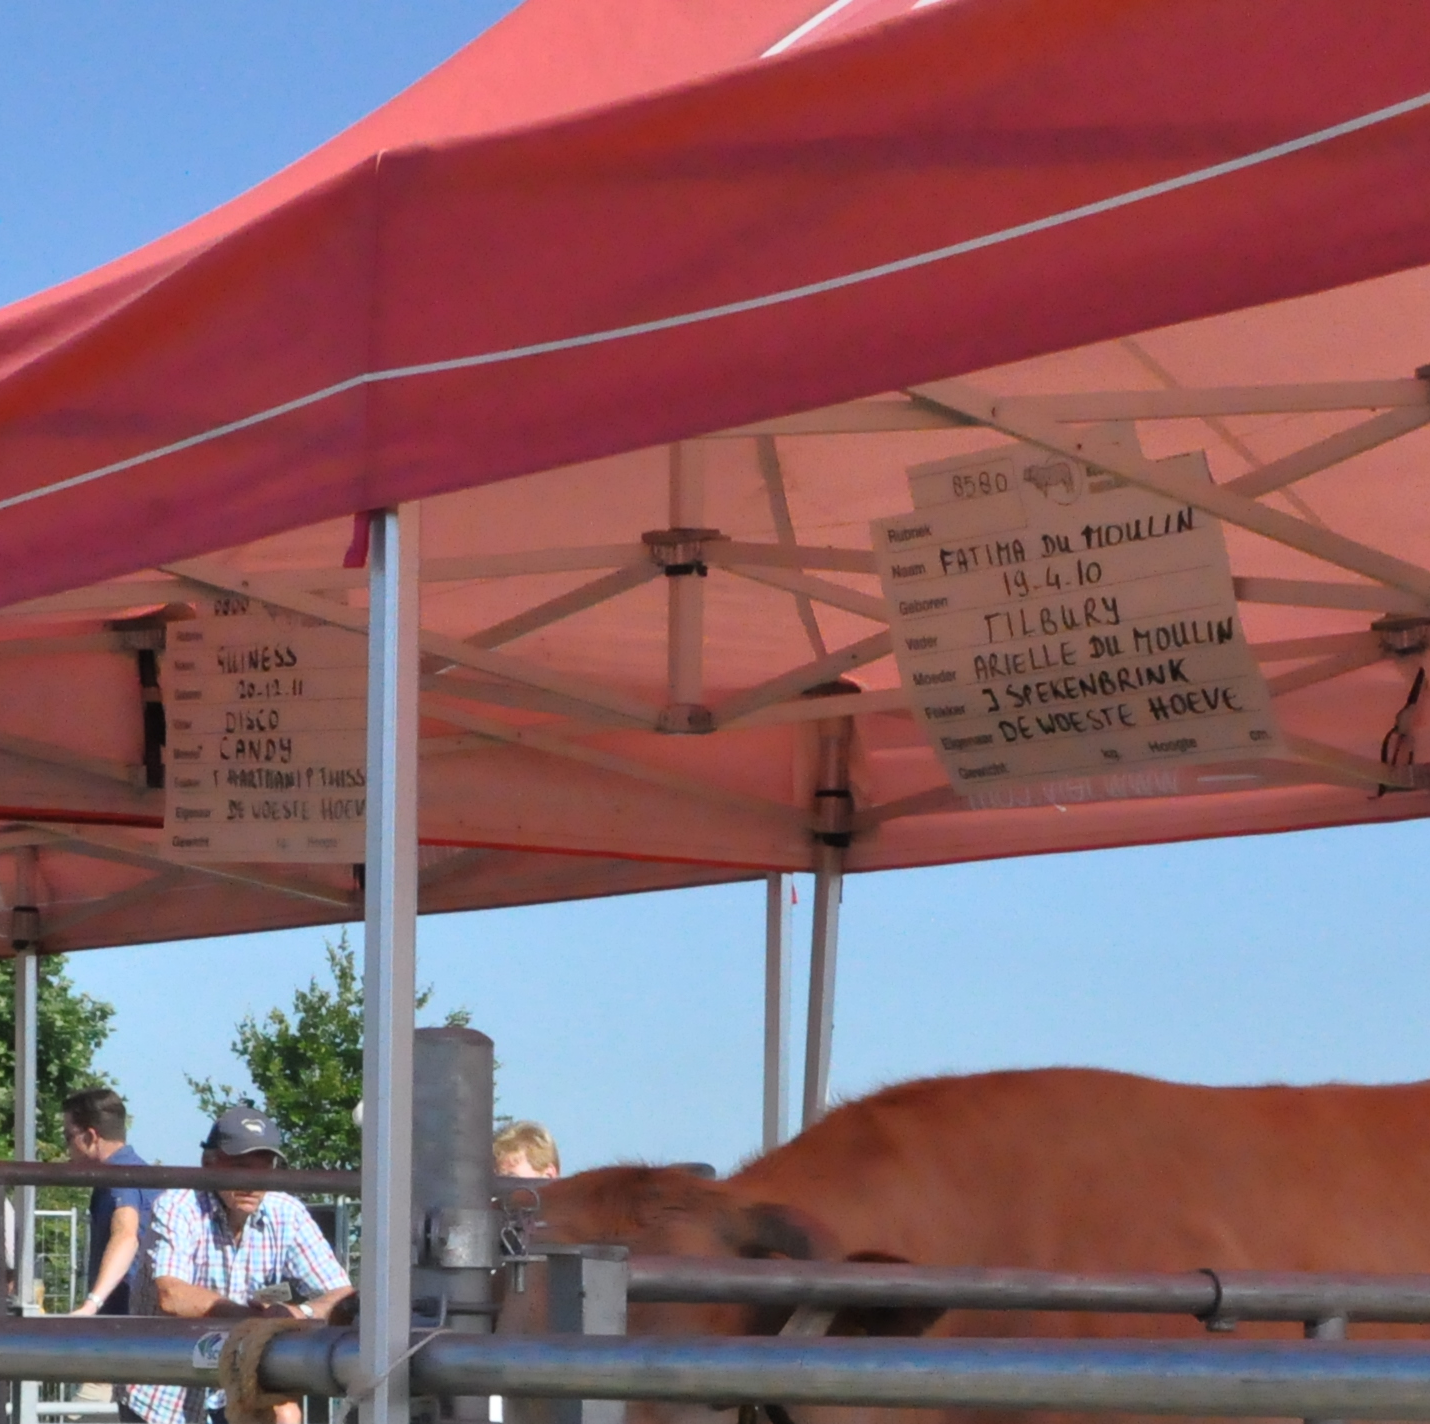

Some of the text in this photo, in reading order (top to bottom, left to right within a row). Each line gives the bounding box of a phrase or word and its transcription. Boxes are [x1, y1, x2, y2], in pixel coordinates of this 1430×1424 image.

[940, 539, 1025, 575] FATIMA
[1081, 506, 1194, 549] MOULIN
[899, 597, 948, 615] Geboren
[984, 597, 1120, 643] TILBURY
[974, 617, 1233, 680] ARIELLE DU MOULIN
[1006, 658, 1190, 708] SPEKENBRINK
[1148, 687, 1242, 720] HOEVE
[220, 736, 292, 763] CANDY
[321, 797, 366, 820] HOEV
